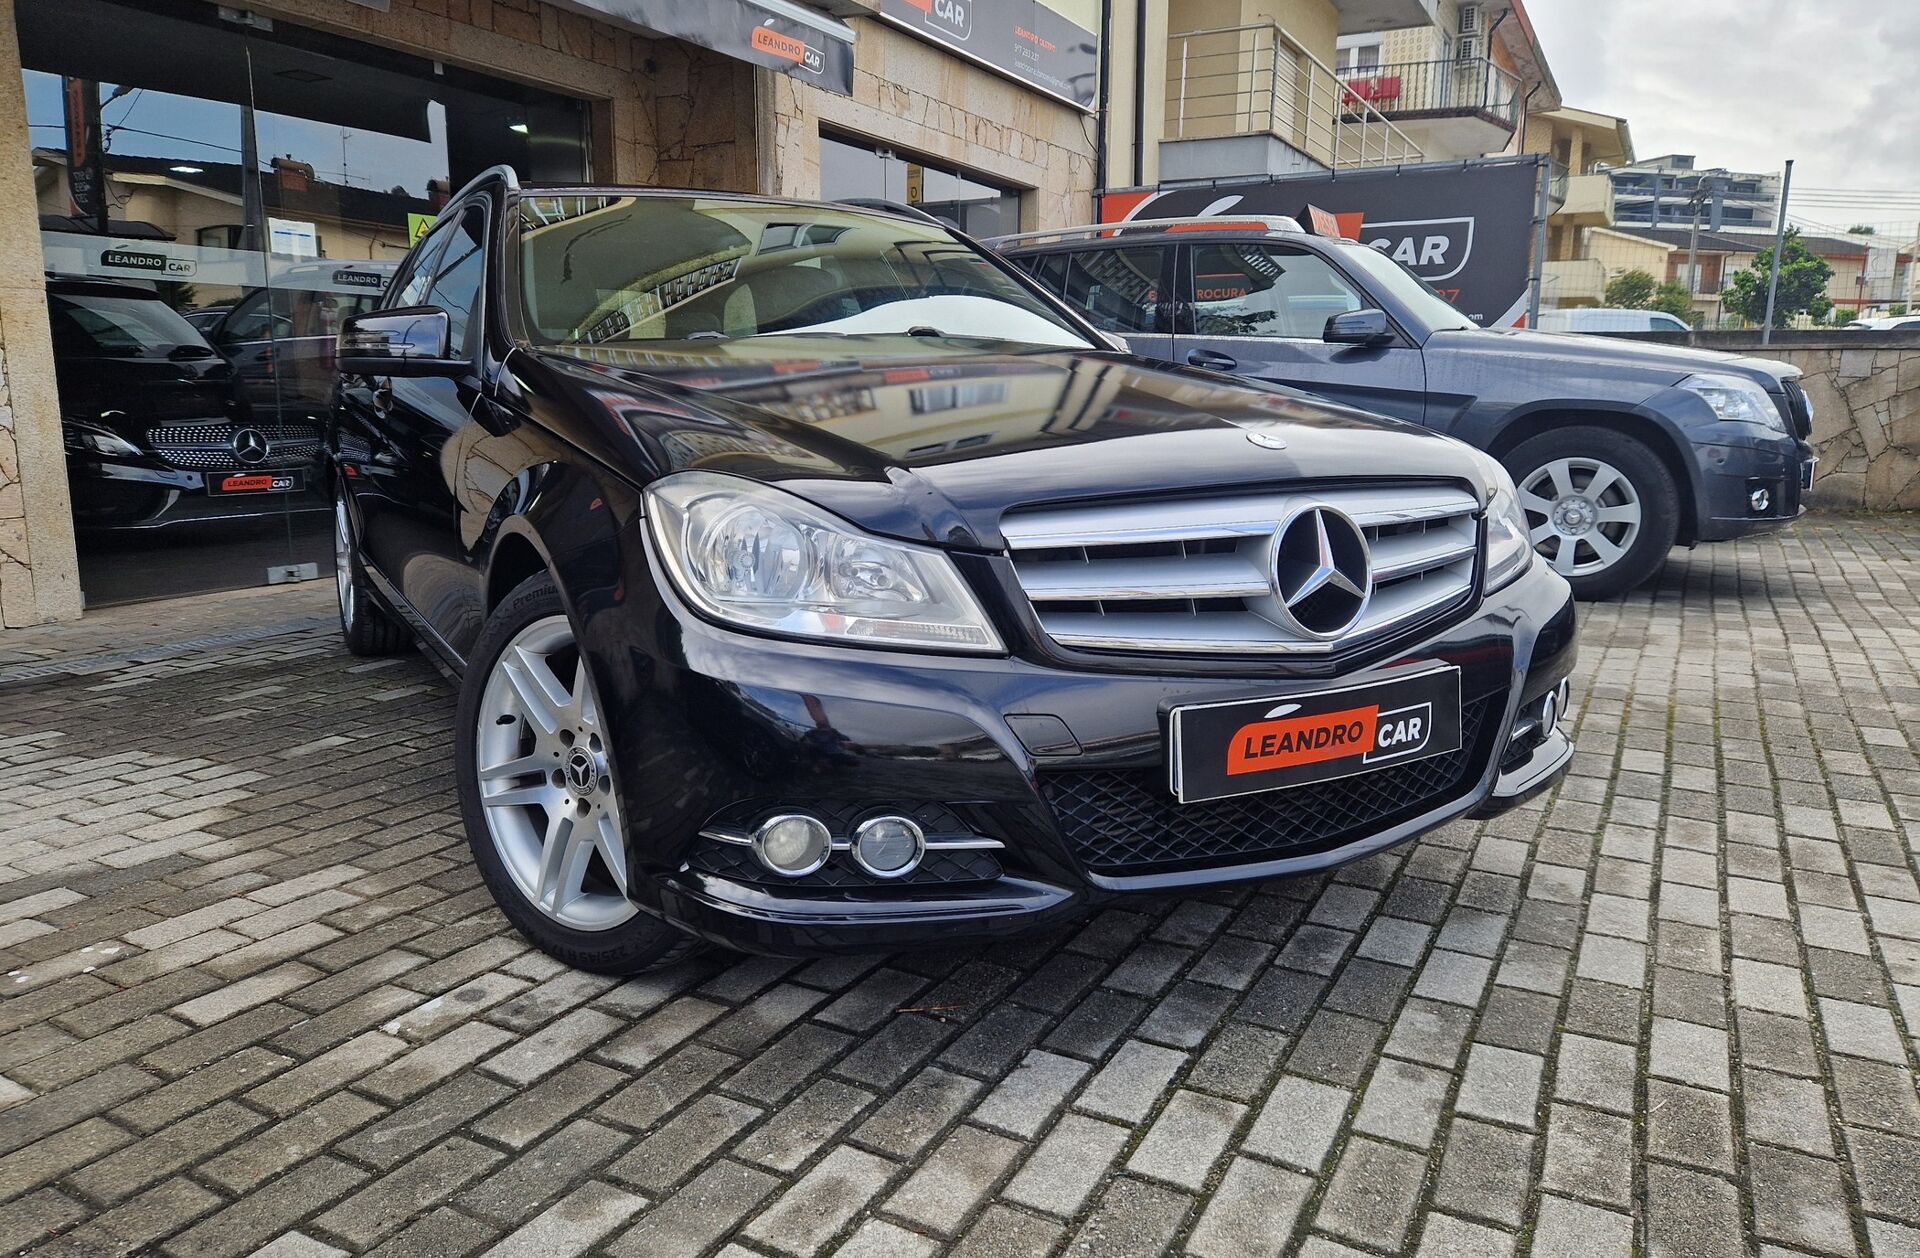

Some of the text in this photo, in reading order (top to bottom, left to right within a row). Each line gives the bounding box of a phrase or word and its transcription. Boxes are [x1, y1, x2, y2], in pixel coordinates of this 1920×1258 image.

[934, 0, 964, 28] CAR
[757, 33, 820, 68] LEANDRO CAR
[108, 254, 191, 273] LEANDRO CAR
[337, 273, 378, 284] LEANDRO
[227, 479, 267, 487] LEANDRO
[512, 584, 559, 609] Premiu
[1243, 717, 1422, 760] LEANDRO CAR
